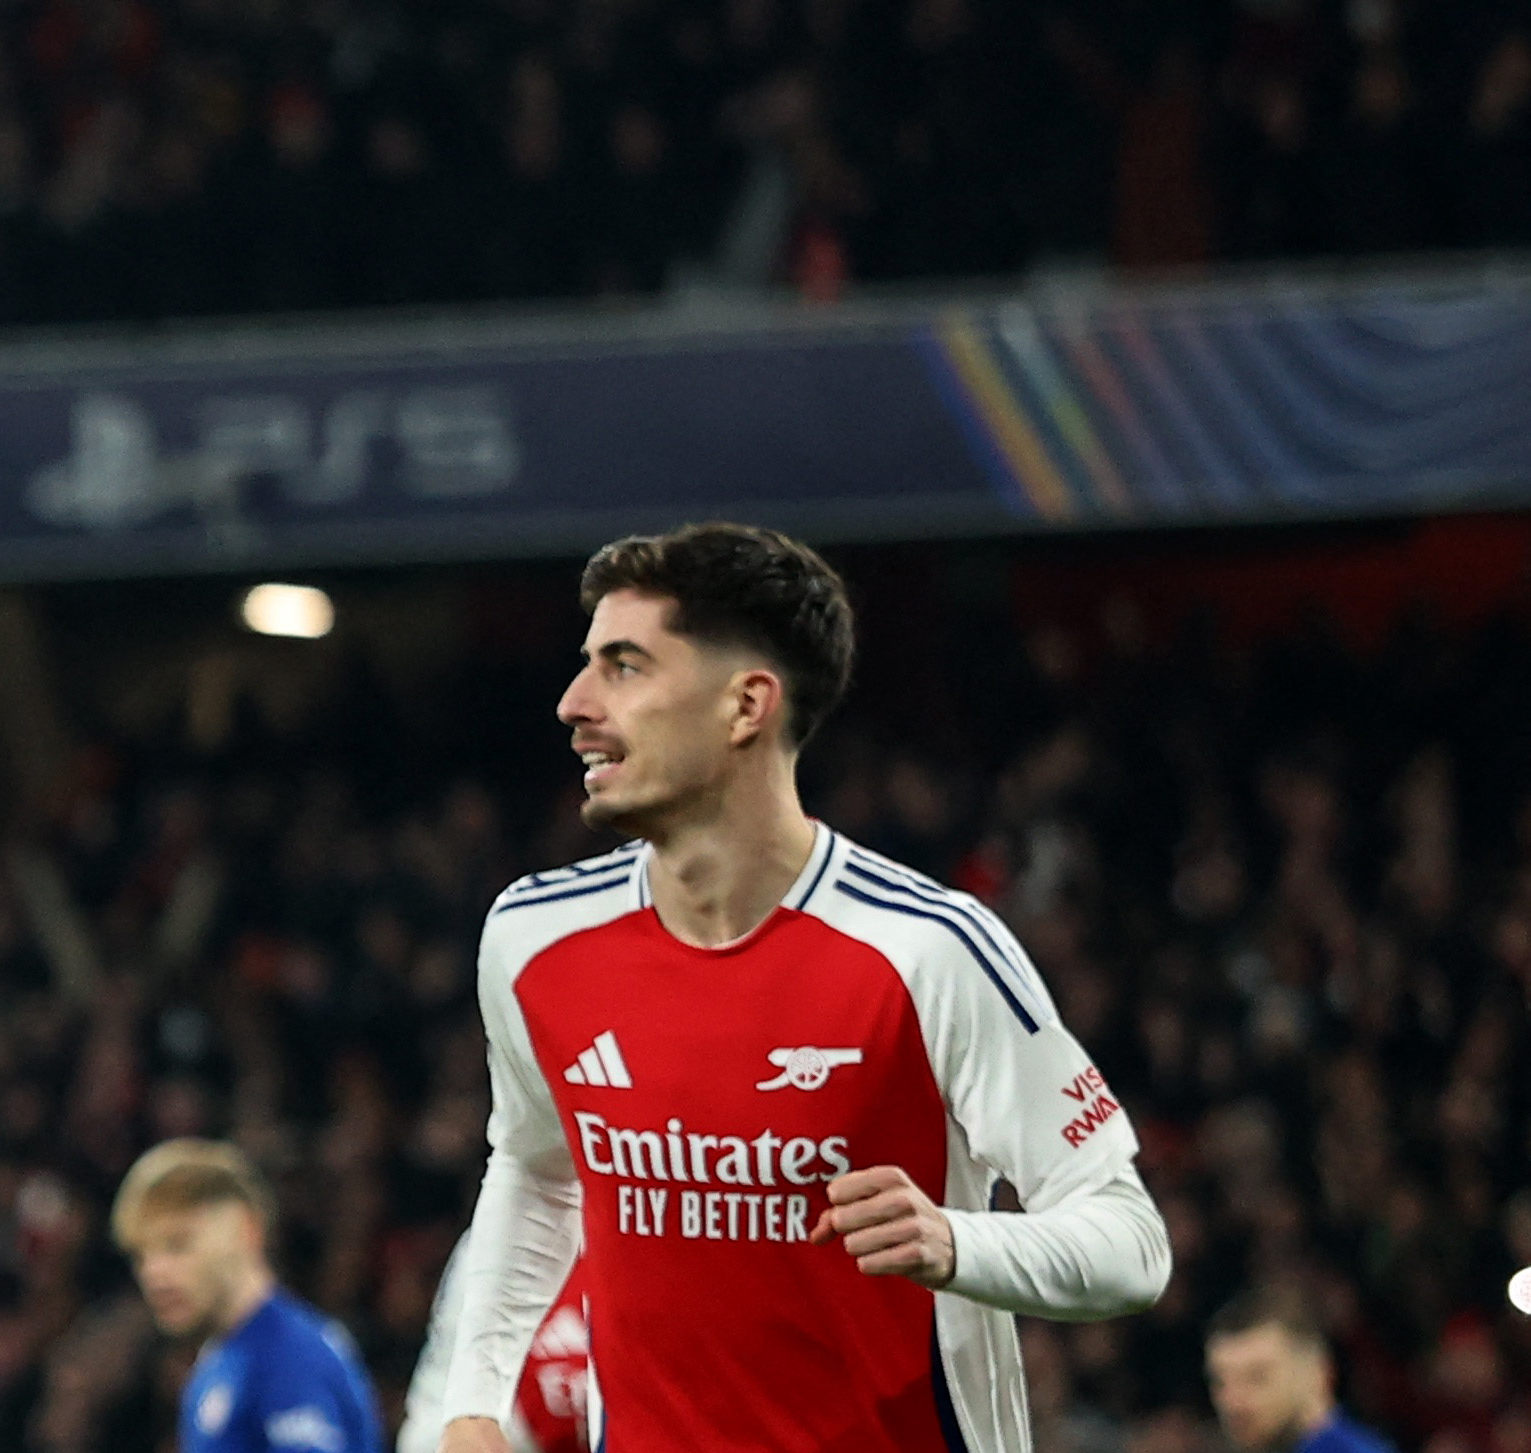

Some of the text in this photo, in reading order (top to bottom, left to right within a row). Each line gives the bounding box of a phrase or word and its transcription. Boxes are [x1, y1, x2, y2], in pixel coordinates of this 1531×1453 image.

[573, 1110, 852, 1187] Emirates
[618, 1185, 810, 1243] FLY BETTER
